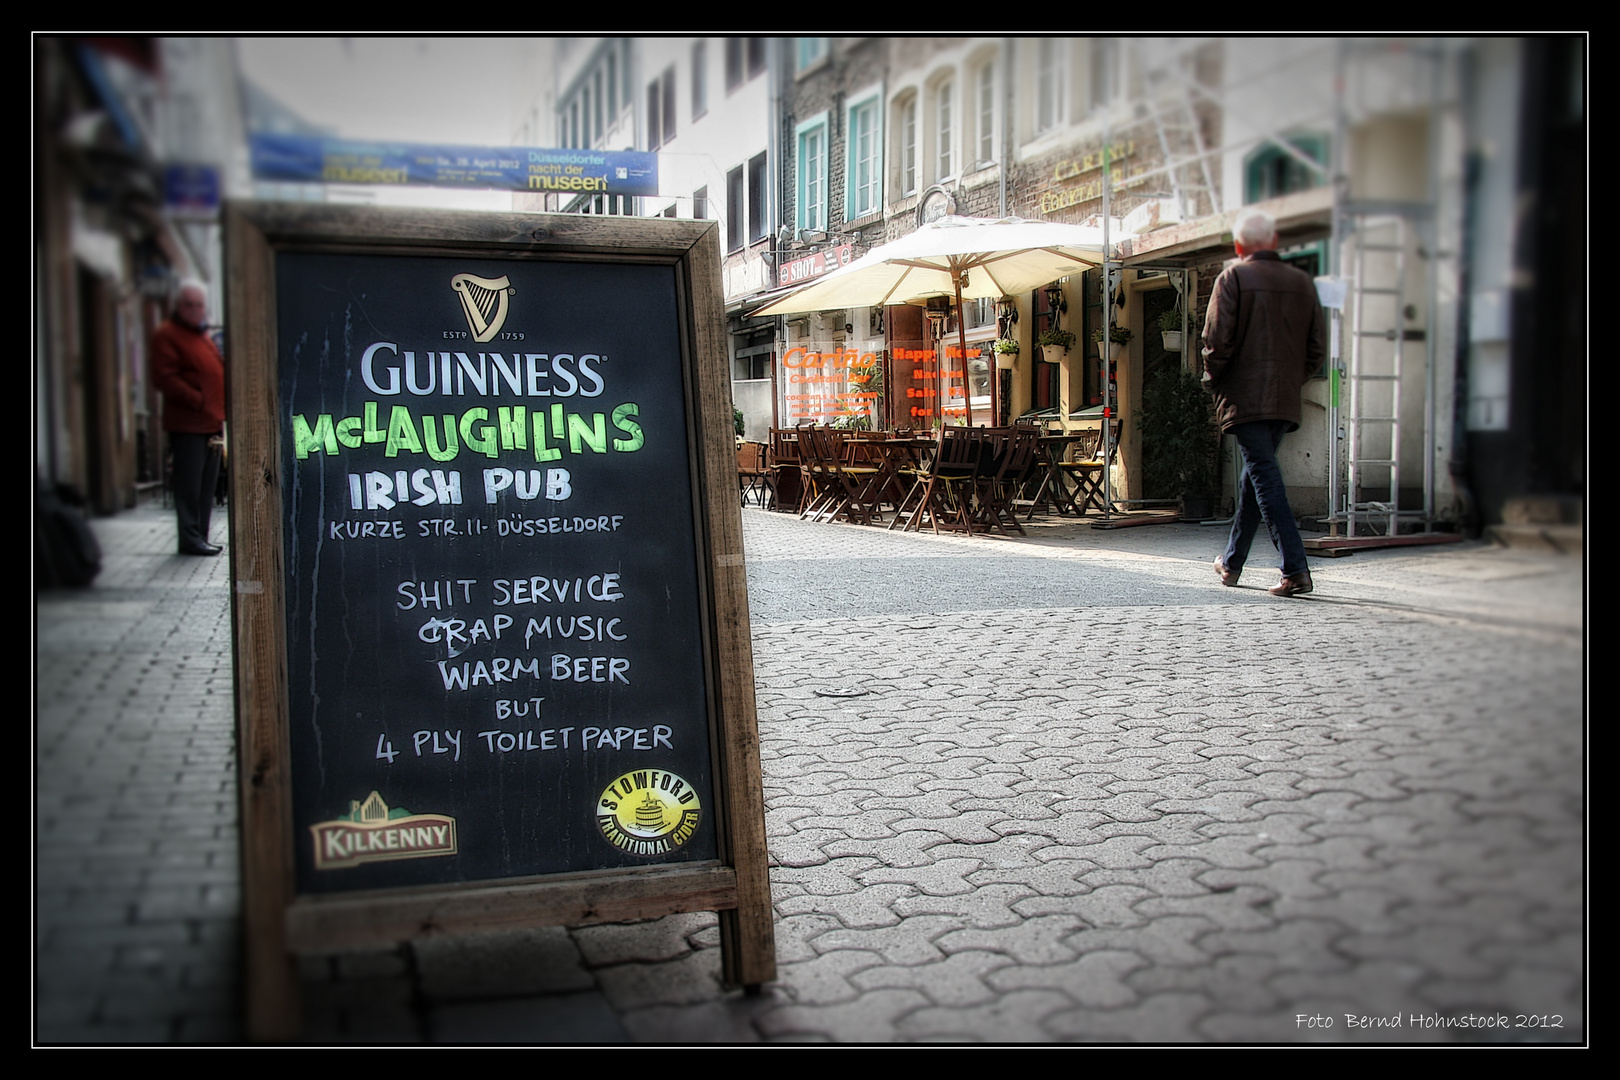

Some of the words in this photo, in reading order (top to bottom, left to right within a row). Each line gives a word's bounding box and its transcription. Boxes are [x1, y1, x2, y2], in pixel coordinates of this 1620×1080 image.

[528, 151, 606, 166] Düsseldorfer
[528, 163, 562, 175] nacht
[564, 165, 585, 176] der
[528, 174, 607, 192] museen
[1041, 182, 1106, 215] COCKTAI
[790, 257, 816, 281] SHOT
[501, 332, 526, 341] 1759
[360, 341, 606, 398] GUINNESS
[783, 347, 877, 369] Cariño
[789, 373, 844, 384] Cocktail
[846, 372, 871, 383] Bar
[948, 386, 971, 398] Di
[910, 406, 933, 417] for
[348, 469, 463, 511] IRISH
[483, 467, 573, 505] PUB
[330, 520, 406, 541] KURZE
[497, 512, 625, 538] DÜSSELDORF
[397, 578, 477, 611] SHIT
[492, 571, 625, 607] SERVICE
[418, 613, 515, 646] CRAP
[524, 614, 629, 650] MUSIC
[437, 656, 541, 691] WARM
[550, 653, 631, 685] BEER
[495, 697, 546, 720] BUT
[374, 732, 401, 764] 4
[412, 728, 462, 762] PLY
[477, 725, 576, 753] TOILET
[581, 723, 675, 752] PAPER
[600, 770, 695, 811] STOWFORD
[323, 824, 450, 859] KILKENNY
[599, 815, 673, 856] TRADITIONAL
[671, 811, 700, 847] CIDER
